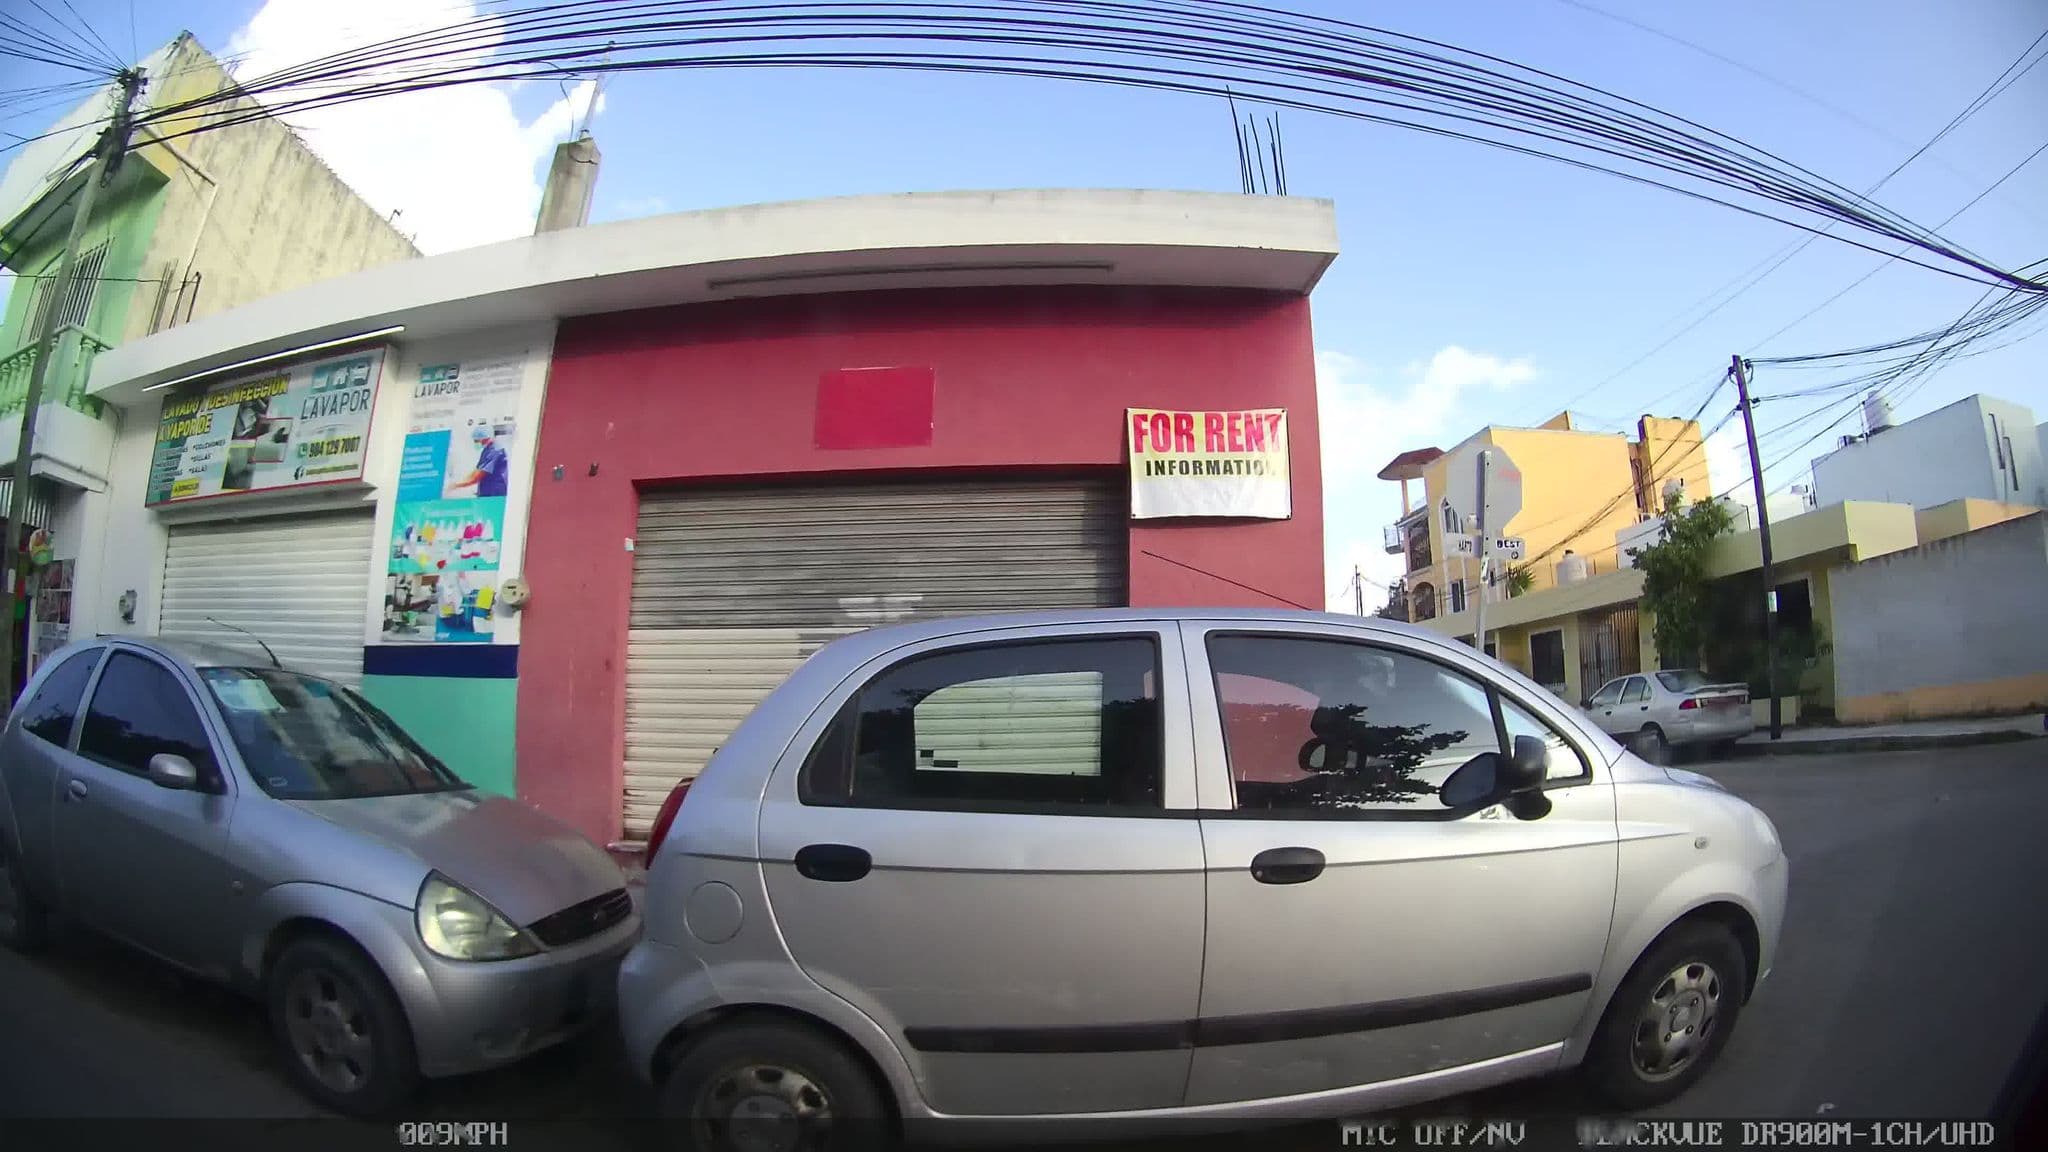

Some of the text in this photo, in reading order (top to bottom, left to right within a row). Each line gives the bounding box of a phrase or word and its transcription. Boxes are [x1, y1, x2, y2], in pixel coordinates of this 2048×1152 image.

[414, 380, 461, 399] LAVAPOR
[300, 388, 371, 420] LAVAPOR
[1133, 413, 1282, 453] FOR RENT
[1146, 459, 1276, 477] INFORMATIO
